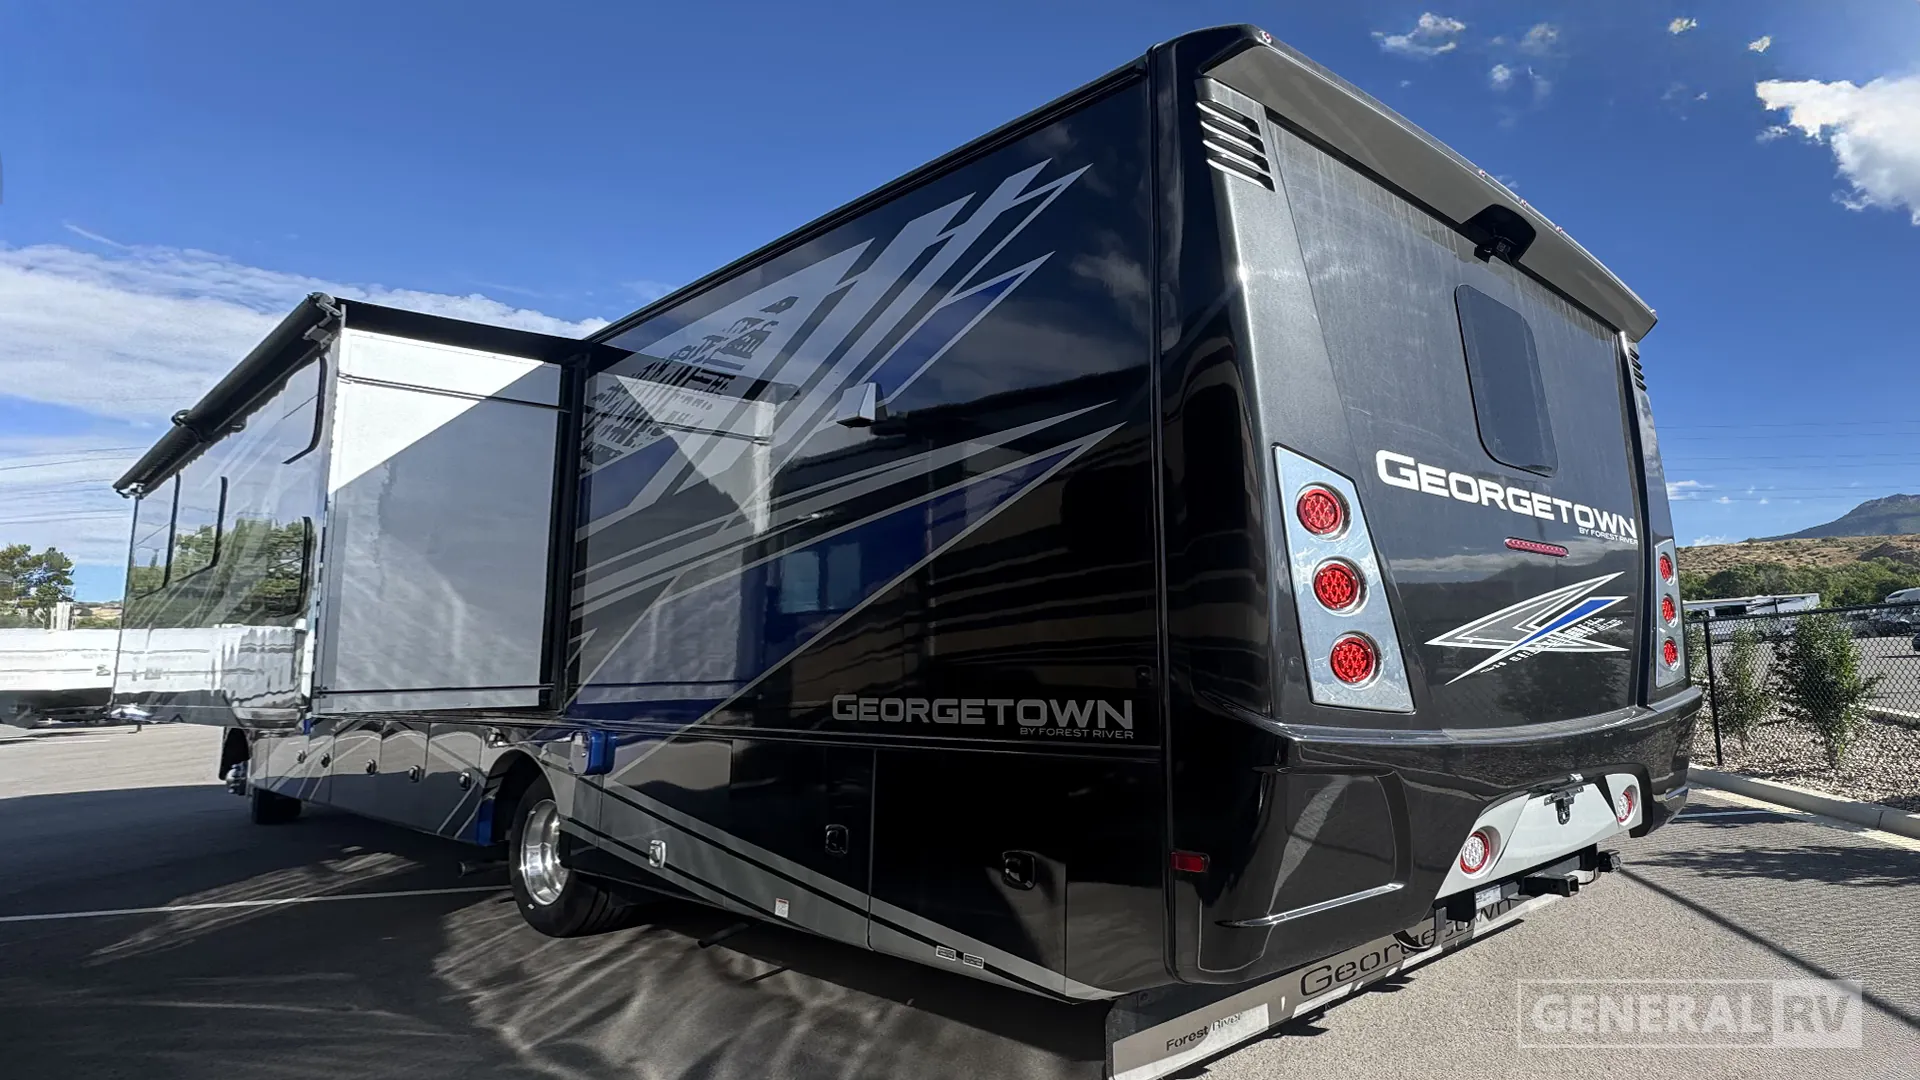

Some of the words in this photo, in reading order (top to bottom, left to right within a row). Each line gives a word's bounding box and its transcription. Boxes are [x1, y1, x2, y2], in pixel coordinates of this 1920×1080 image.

[1376, 449, 1638, 539] GEORGETOWN
[1578, 527, 1590, 535] BY
[1590, 530, 1619, 541] FOREST
[1619, 536, 1639, 546] RIVER
[832, 694, 1133, 730] GEORGETOWN
[1020, 727, 1036, 736] BY
[1038, 728, 1090, 738] FOREST
[1092, 729, 1134, 740] RIVER
[1166, 1025, 1209, 1051] Forest
